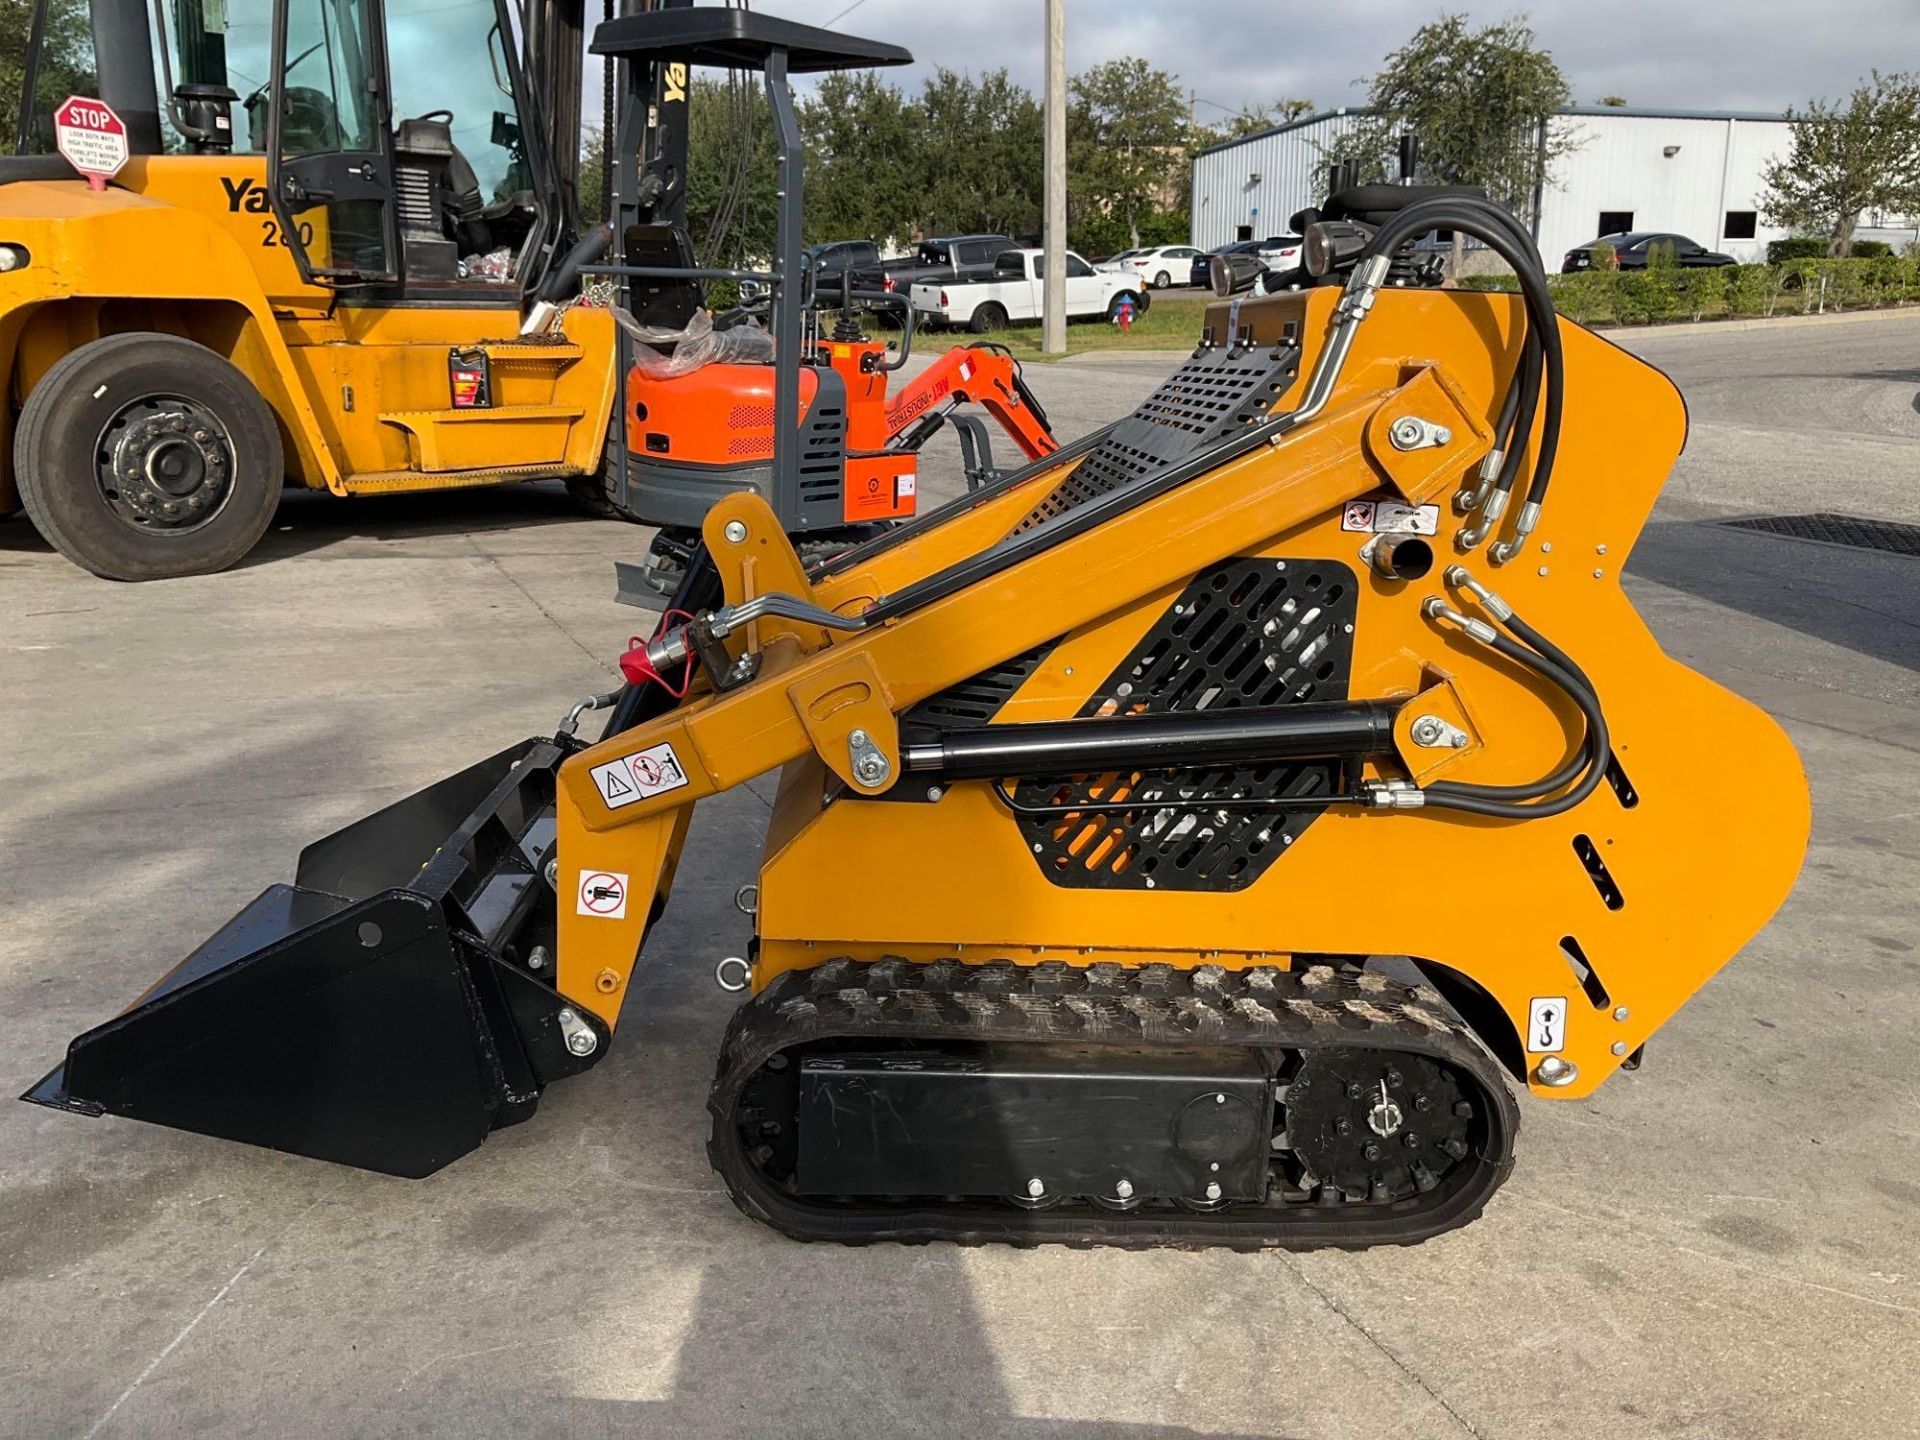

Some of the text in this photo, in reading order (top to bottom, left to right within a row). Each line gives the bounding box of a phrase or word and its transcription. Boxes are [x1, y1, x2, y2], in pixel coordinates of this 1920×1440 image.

[69, 106, 110, 129] STOP
[68, 130, 84, 138] LOOK
[85, 132, 99, 140] BOTH
[67, 138, 118, 152] HIGH TRAFFIC AREA
[69, 147, 97, 158] FORKLIFTS
